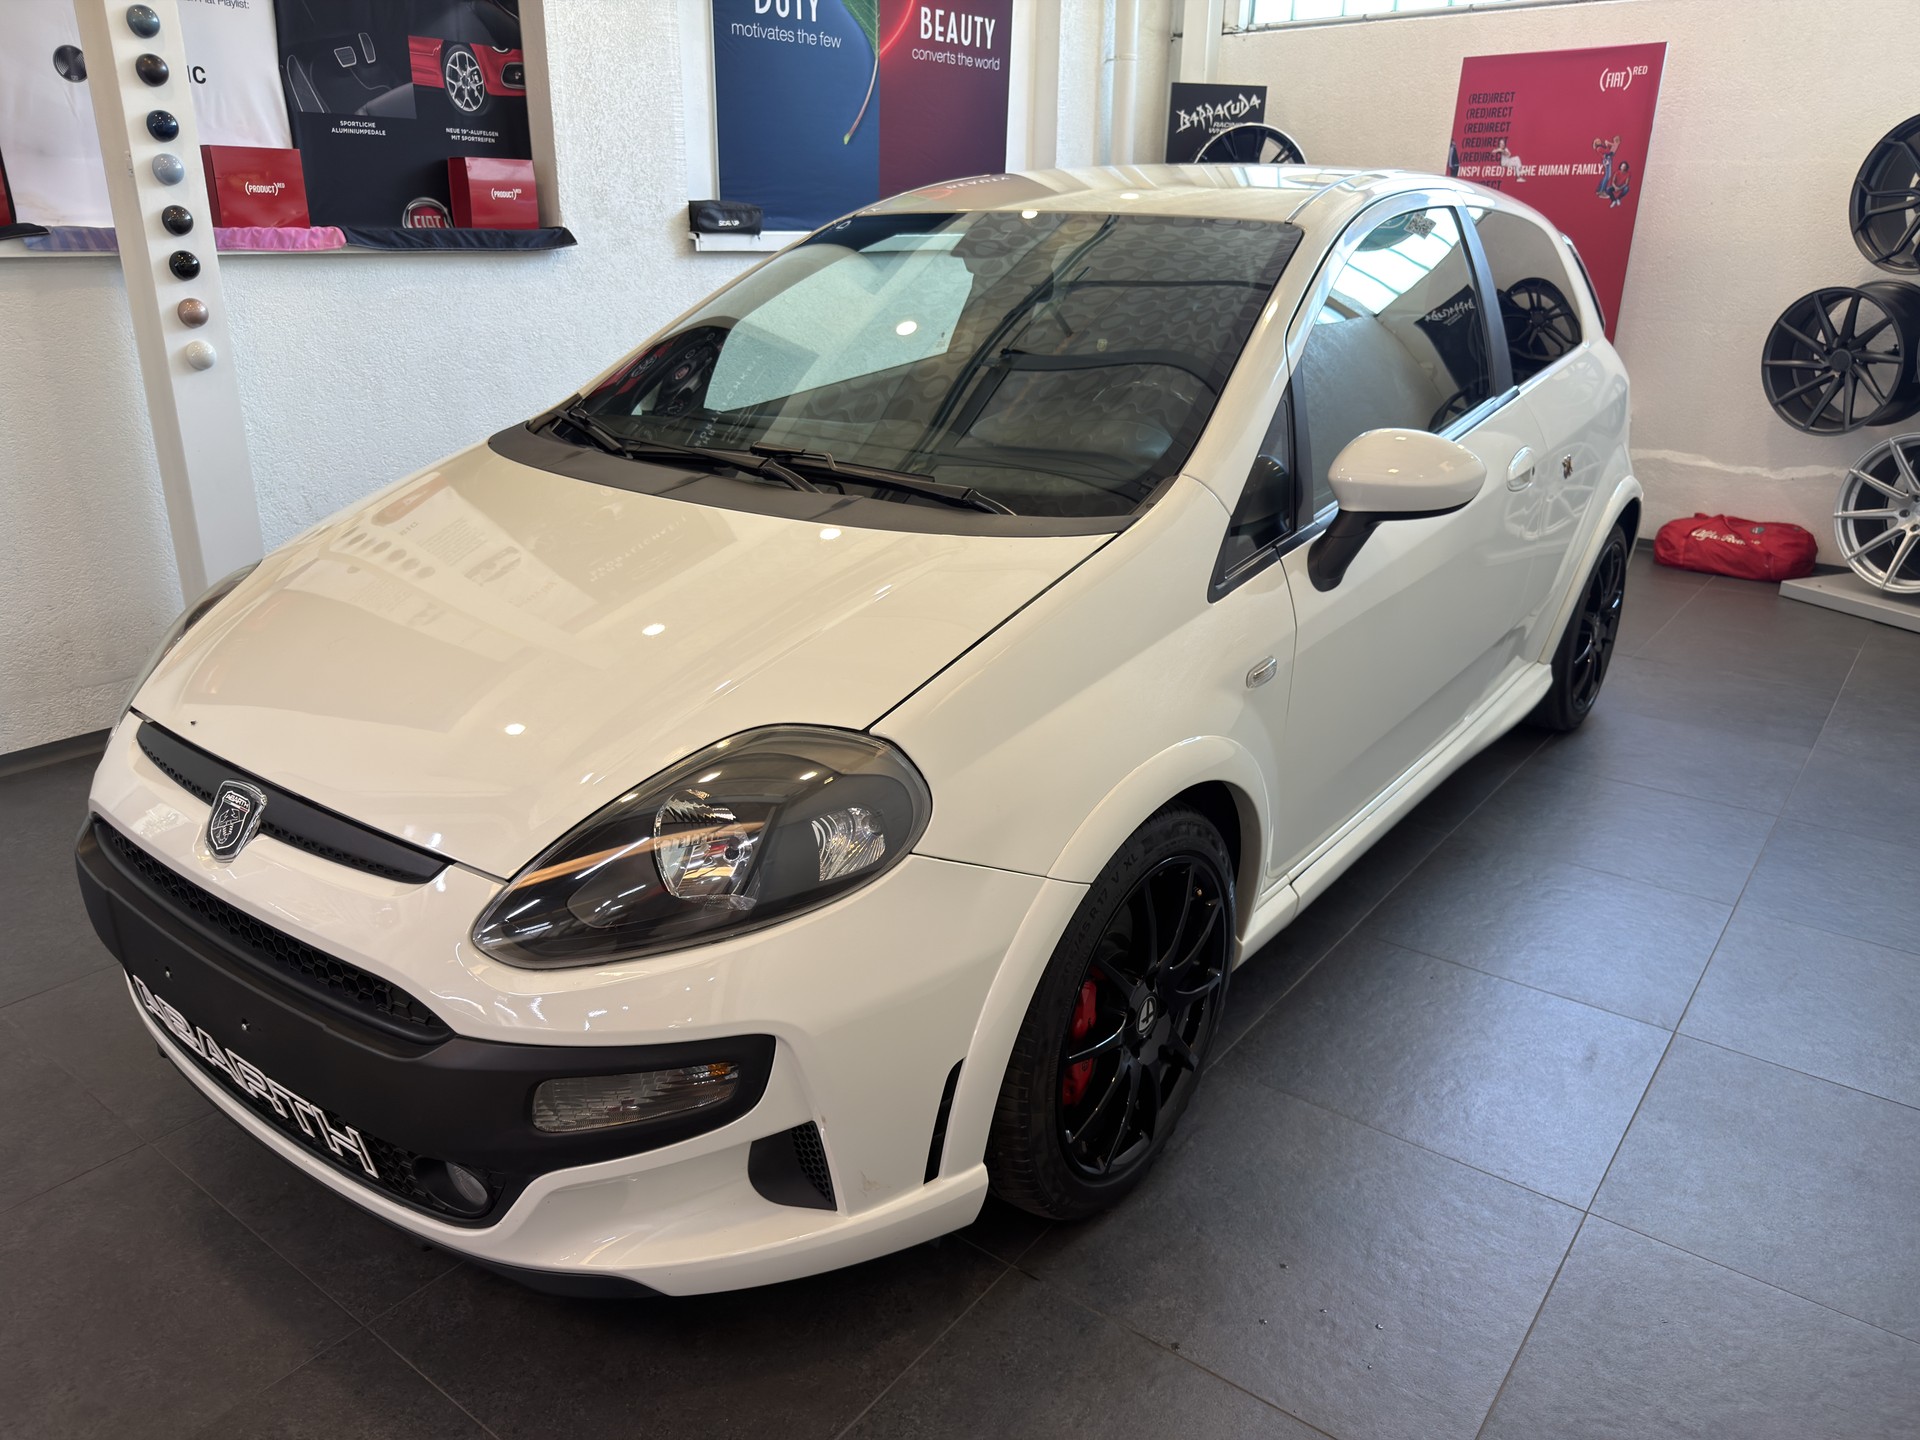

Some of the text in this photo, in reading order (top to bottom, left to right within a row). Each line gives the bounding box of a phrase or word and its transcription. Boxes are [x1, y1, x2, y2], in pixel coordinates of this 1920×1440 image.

[754, 0, 818, 22] DUTY
[920, 6, 996, 50] BEAUTY
[731, 23, 842, 49] motivates the few
[911, 48, 1001, 71] converts the world
[1468, 91, 1516, 105] (RED)IRECT
[1175, 93, 1262, 134] BARRACUDA
[1466, 107, 1514, 120] (RED)IRECT
[331, 127, 387, 136] ALUMINIUMPEDALE
[340, 120, 377, 129] SPORTLICHE
[1463, 121, 1512, 135] (RED)IRECT
[461, 135, 496, 144] SPORTREIFEN
[1538, 164, 1571, 176] HUMAN
[1571, 163, 1606, 175] FAMILY.
[225, 793, 250, 808] ABARTH
[133, 974, 379, 1178] ABARTH
